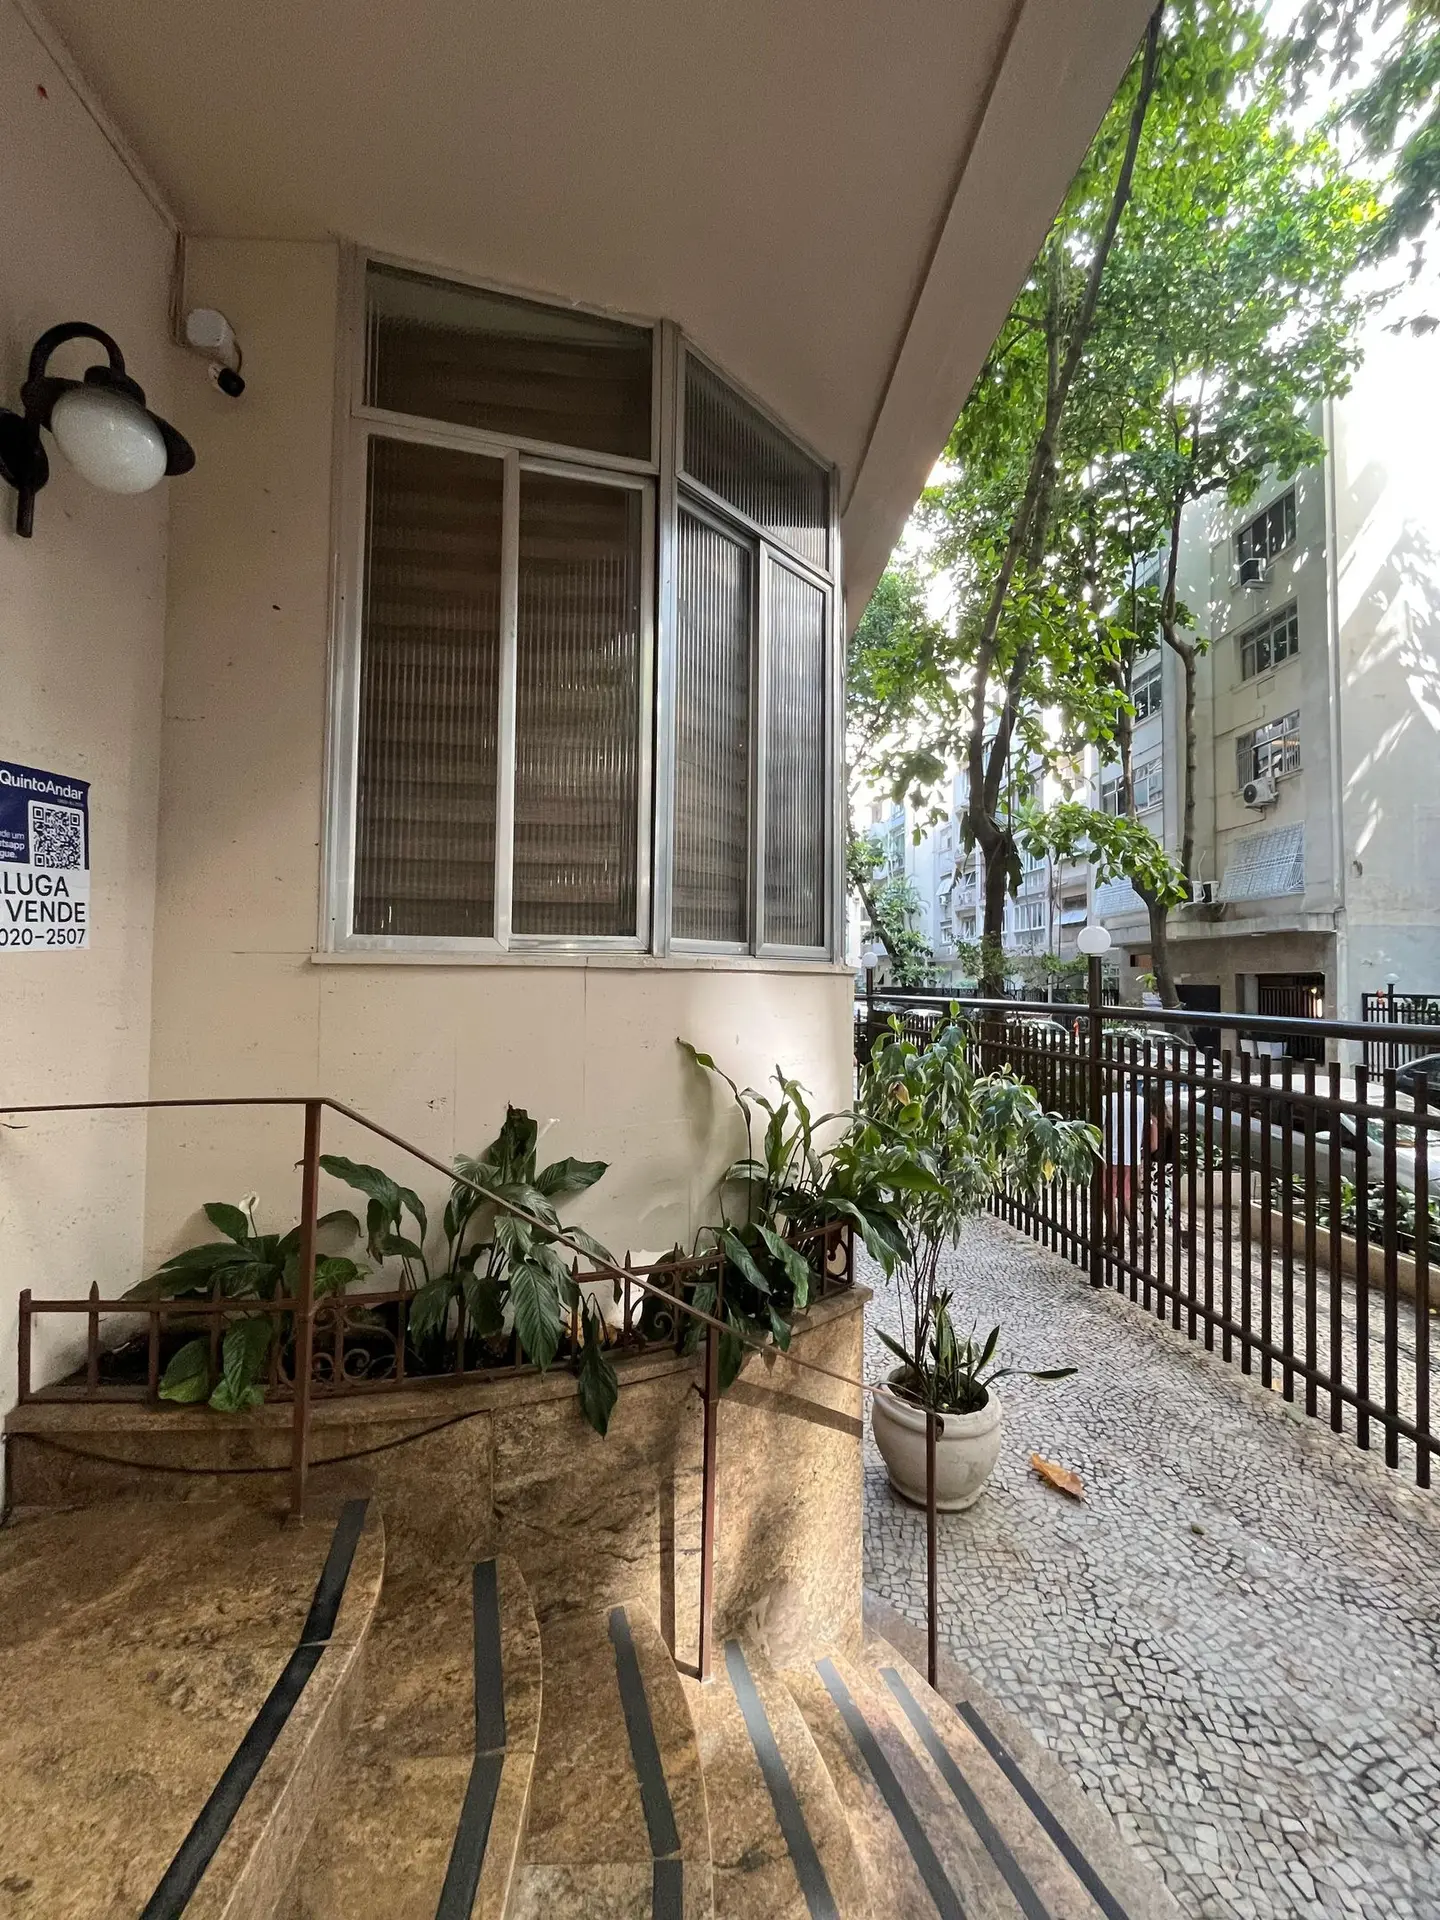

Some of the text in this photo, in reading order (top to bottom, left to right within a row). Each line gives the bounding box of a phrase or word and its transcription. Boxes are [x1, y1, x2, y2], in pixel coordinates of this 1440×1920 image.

[0, 769, 84, 800] QuintoAndar
[0, 871, 70, 897] LUGA
[5, 899, 86, 923] VENDE
